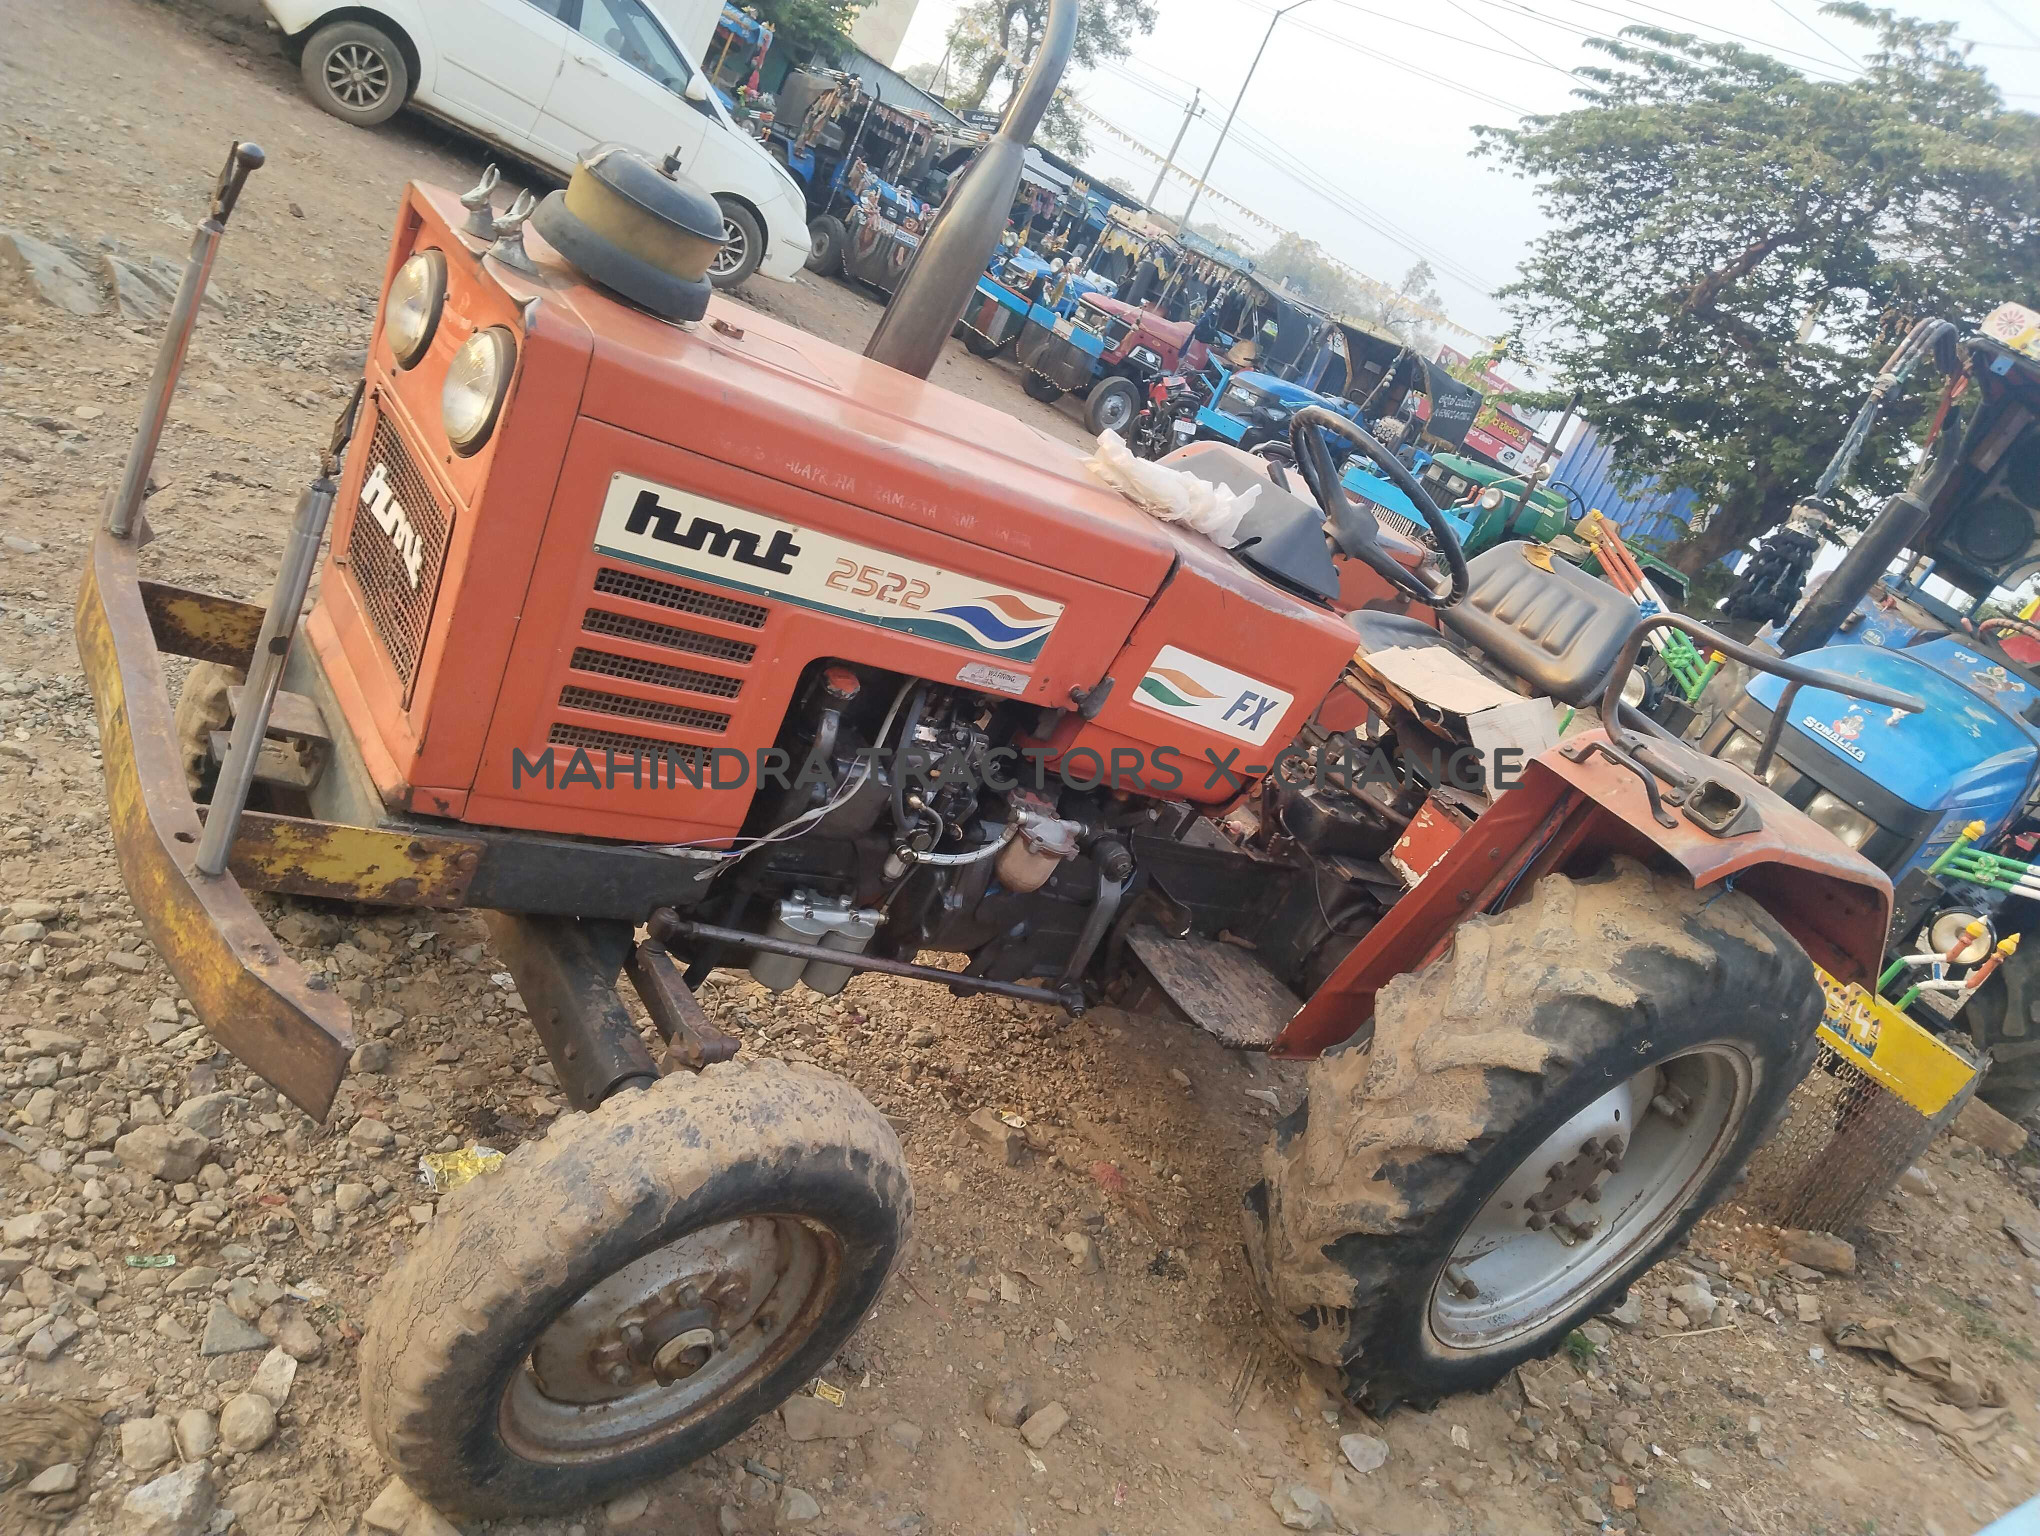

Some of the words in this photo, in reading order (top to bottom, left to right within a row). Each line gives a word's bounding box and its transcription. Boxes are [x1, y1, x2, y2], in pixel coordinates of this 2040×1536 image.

[360, 462, 424, 590] hmt
[624, 489, 802, 575] hmt
[824, 556, 931, 611] 2522
[988, 669, 1017, 684] WARNING
[1220, 689, 1279, 731] FX
[1802, 715, 1886, 763] SONALIKA
